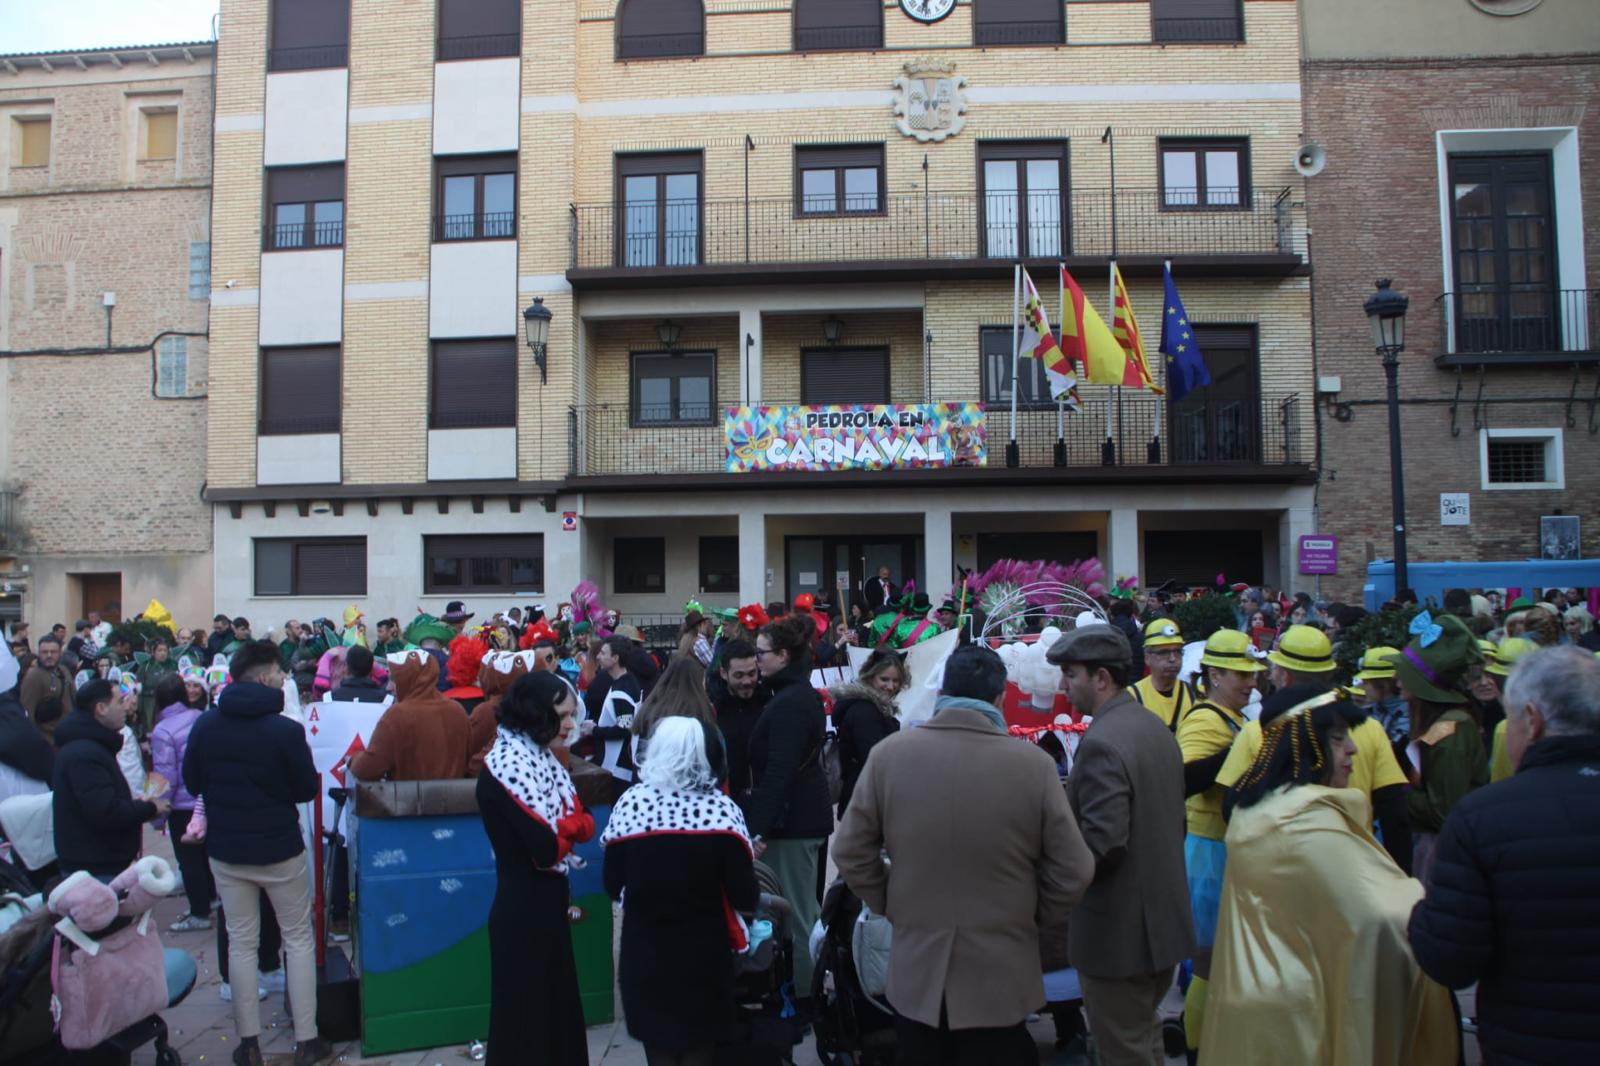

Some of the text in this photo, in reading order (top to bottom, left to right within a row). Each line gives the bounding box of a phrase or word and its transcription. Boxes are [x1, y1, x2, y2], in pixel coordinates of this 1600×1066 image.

[807, 411, 924, 428] PEDROLA EN
[766, 436, 945, 464] CARNAVAL
[309, 707, 320, 721] A
